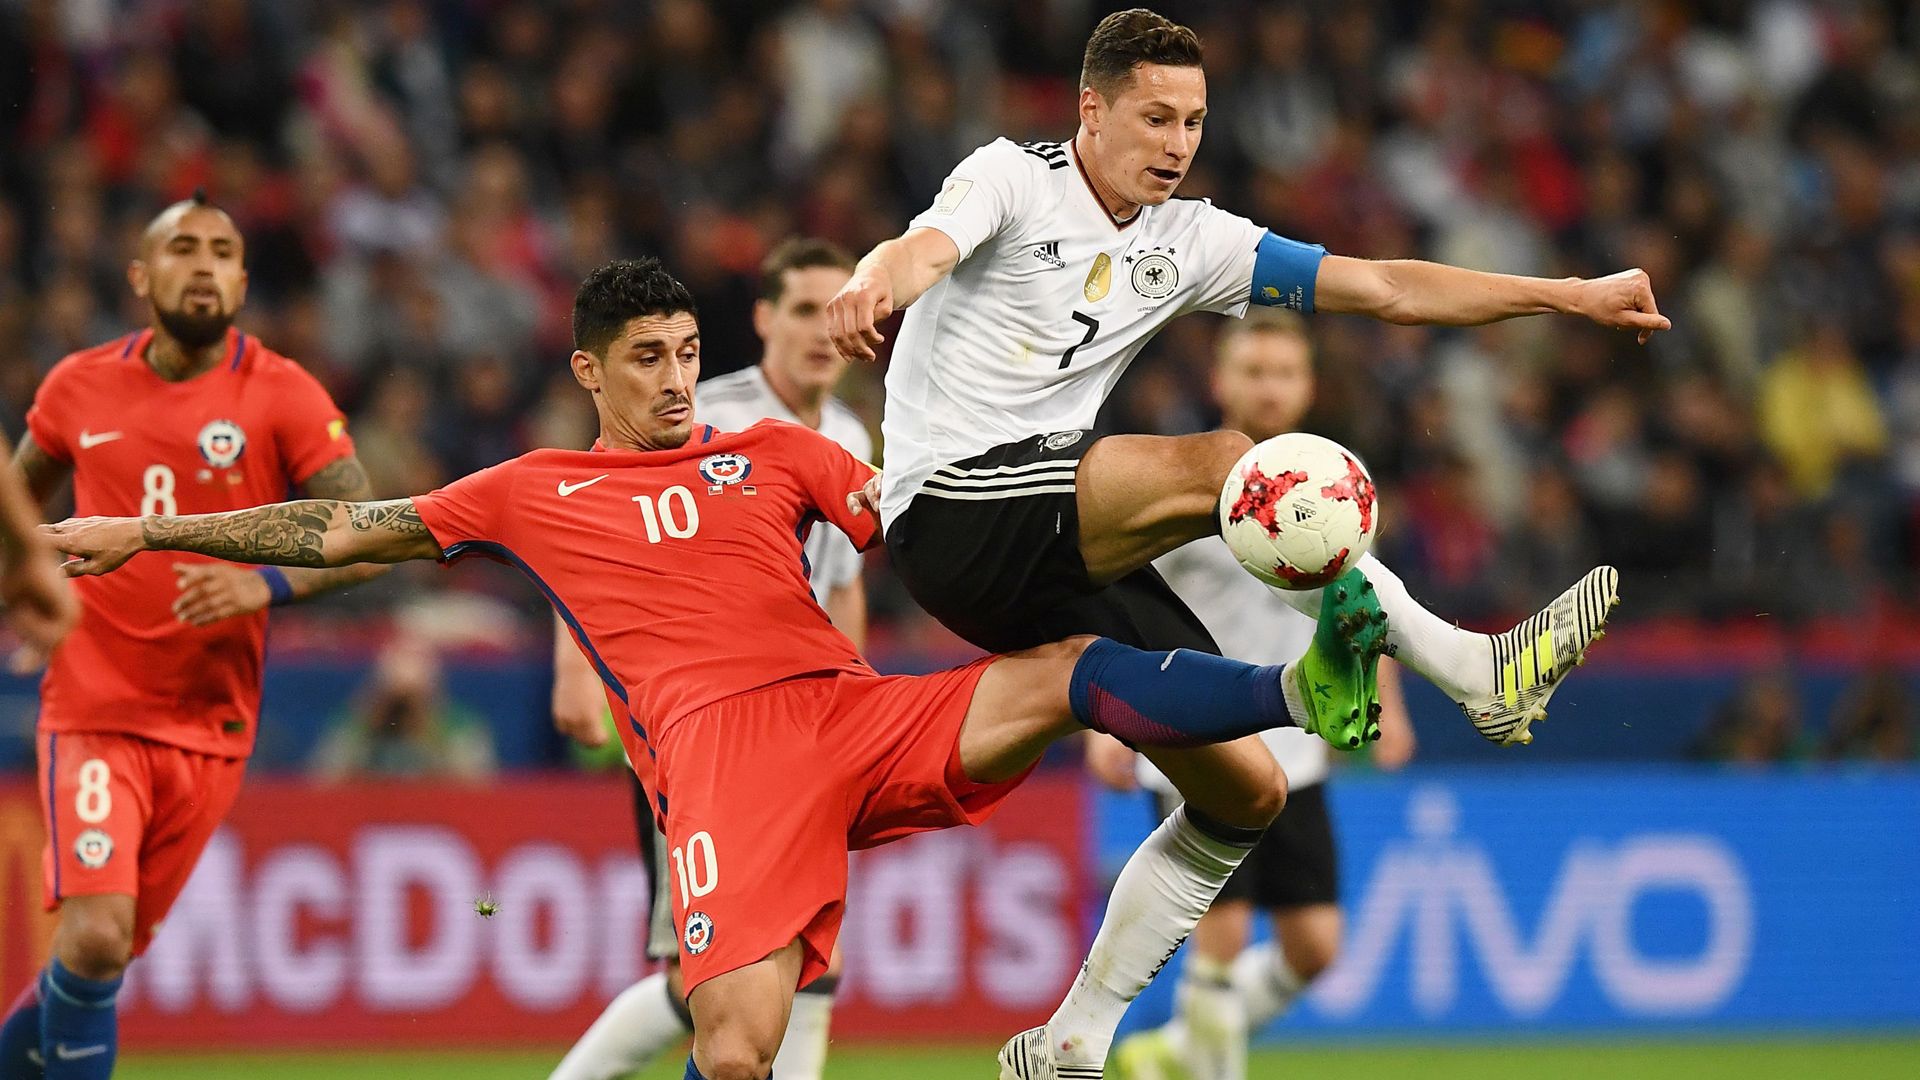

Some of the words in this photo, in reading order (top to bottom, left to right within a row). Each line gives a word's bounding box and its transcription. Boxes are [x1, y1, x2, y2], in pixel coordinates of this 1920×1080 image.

[1033, 249, 1067, 269] adidas
[1057, 310, 1100, 370] 7
[139, 464, 178, 518] 8
[631, 484, 700, 544] 10
[74, 758, 113, 824] 8
[671, 830, 719, 910] 10
[115, 820, 1077, 1012] McDod's
